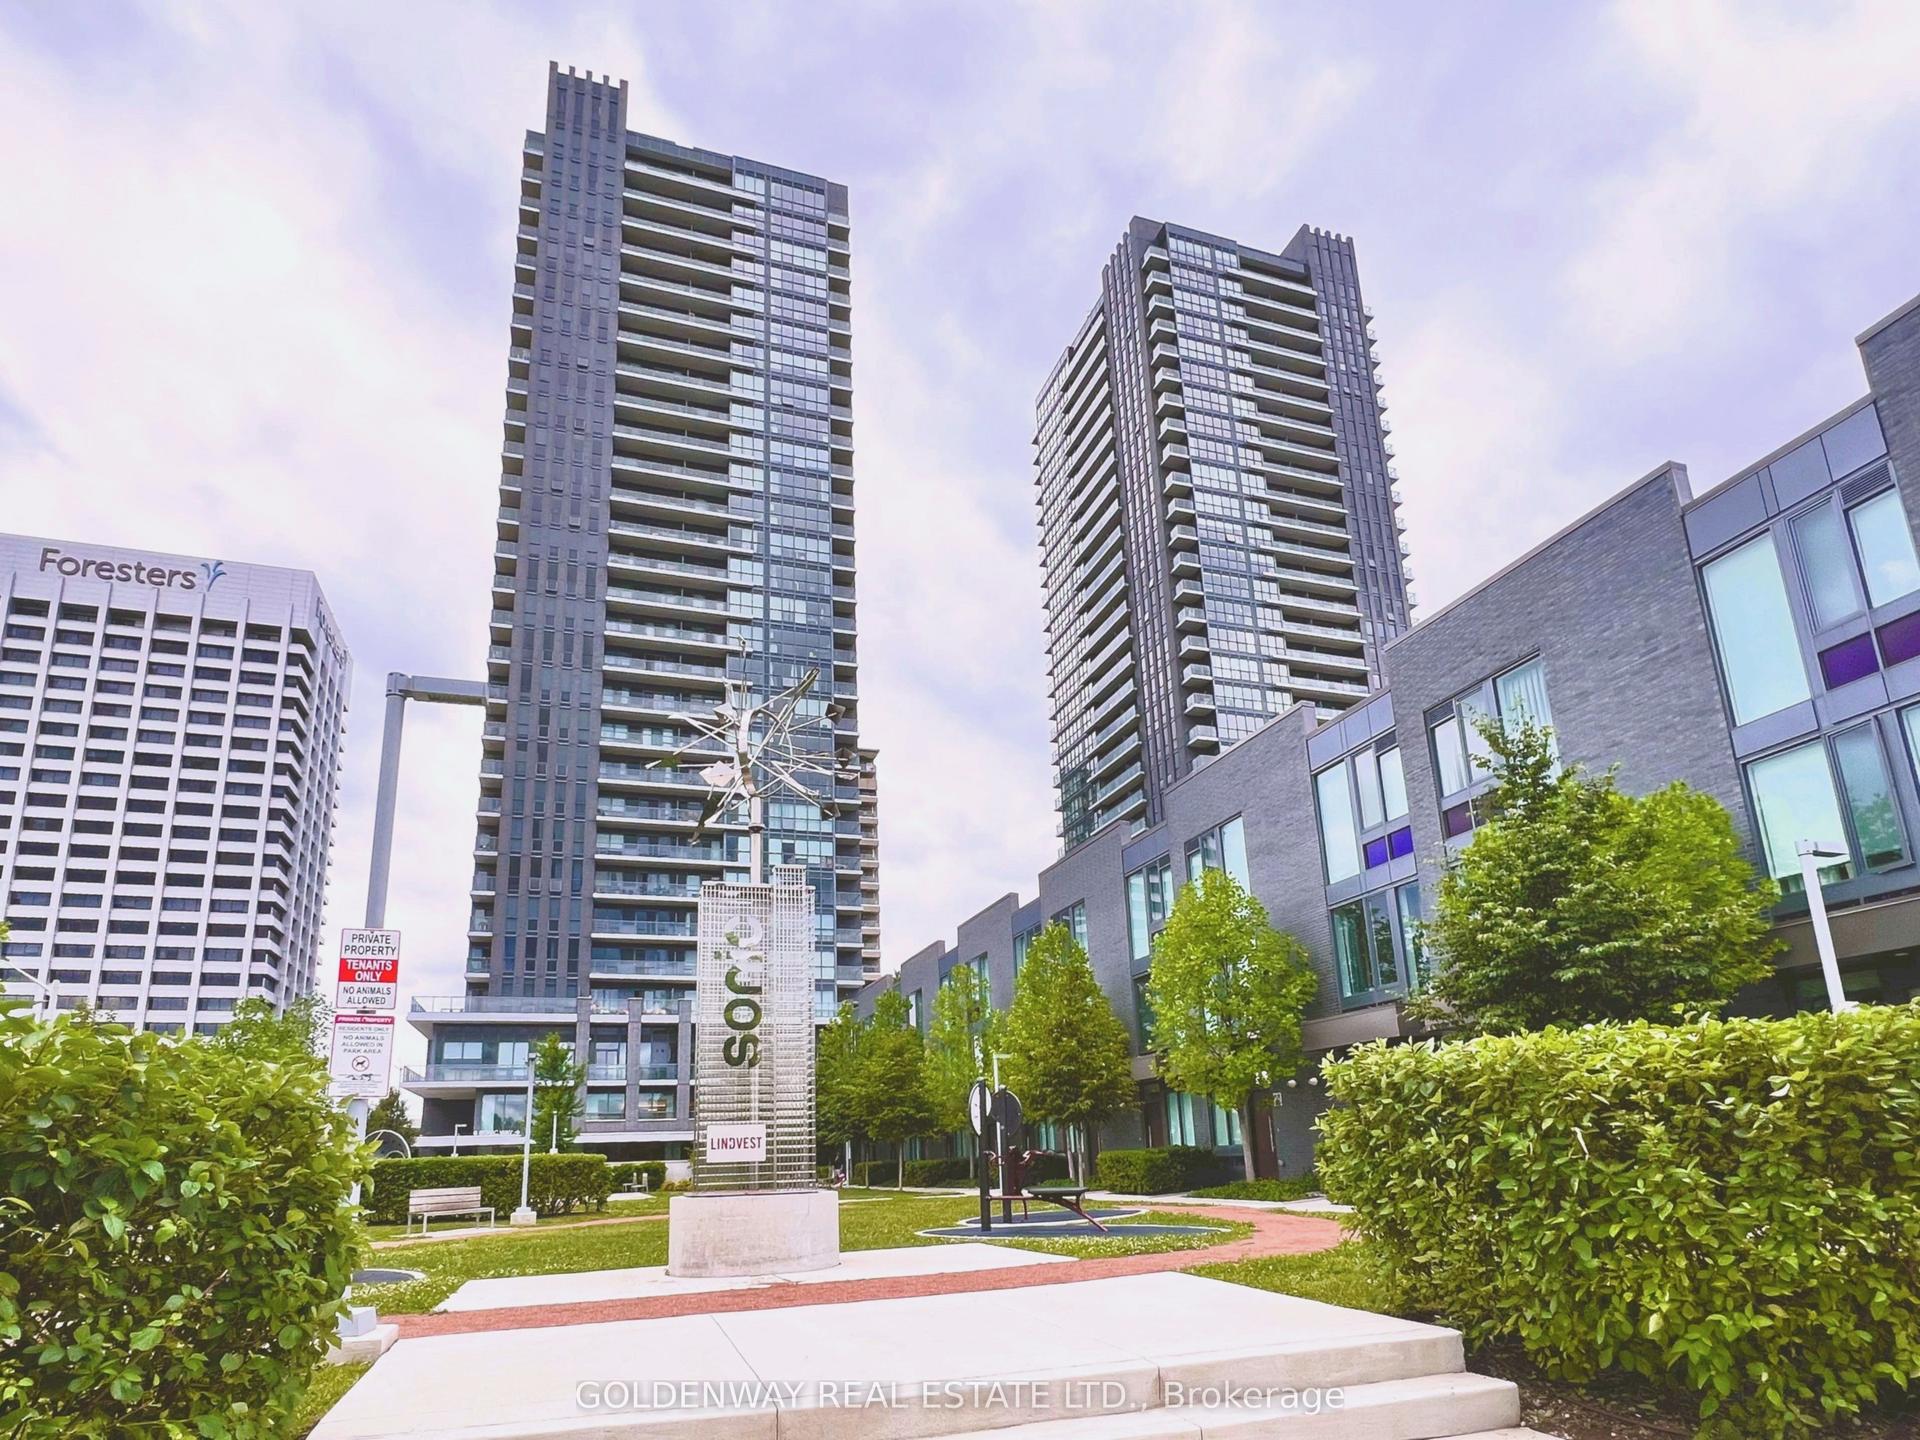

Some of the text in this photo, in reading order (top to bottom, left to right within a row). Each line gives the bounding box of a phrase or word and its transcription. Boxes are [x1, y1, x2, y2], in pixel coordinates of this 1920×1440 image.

[39, 547, 197, 590] Foresters
[351, 933, 391, 944] PRIVATE
[344, 944, 396, 956] PROPERTY
[346, 959, 393, 971] TENANTS
[355, 970, 382, 981] ONLY
[343, 986, 392, 996] NO ANIMALS
[347, 996, 386, 1005] ALLOWED
[710, 1136, 762, 1150] LINDVEST
